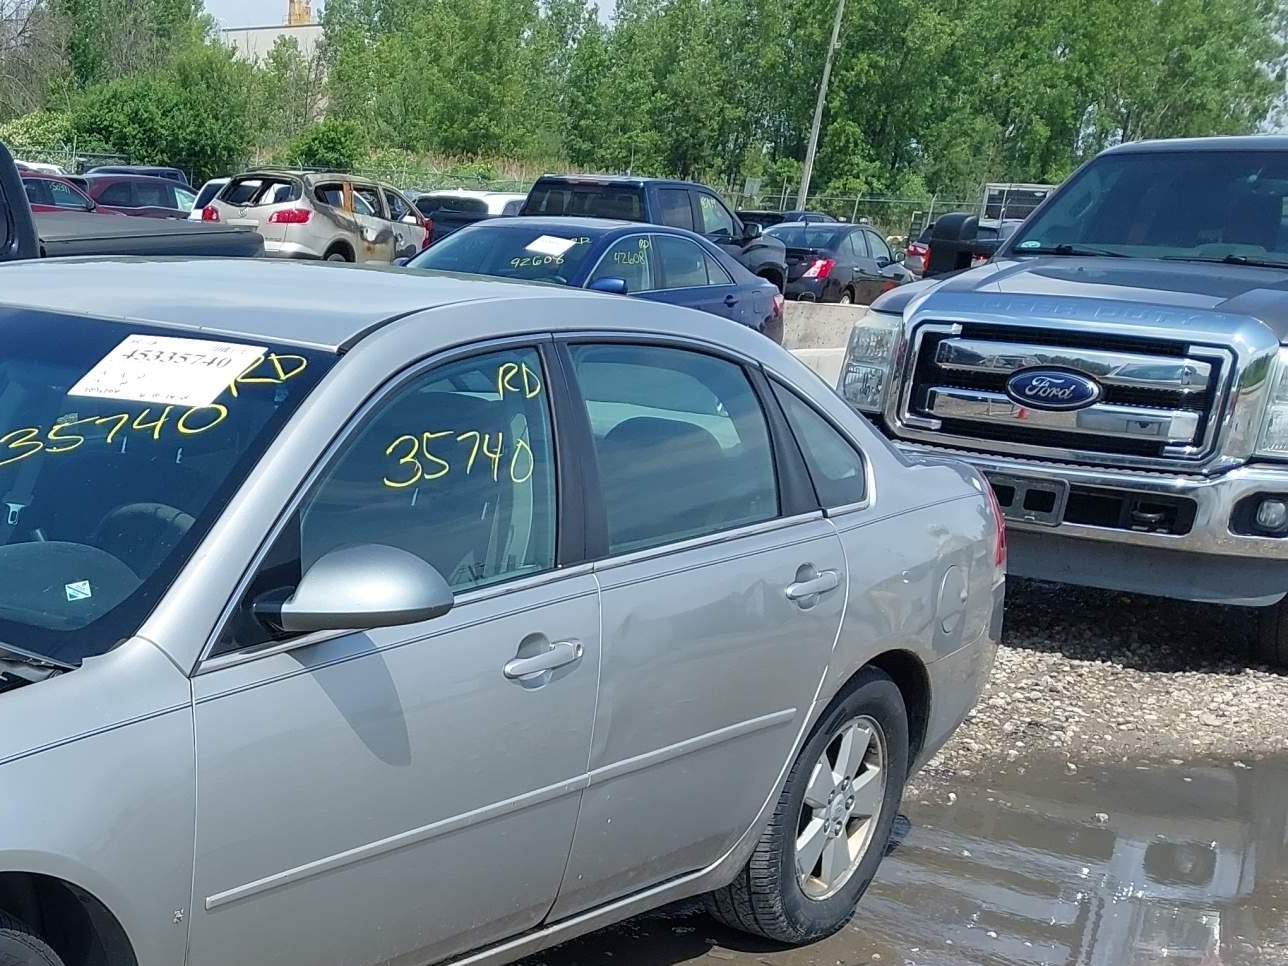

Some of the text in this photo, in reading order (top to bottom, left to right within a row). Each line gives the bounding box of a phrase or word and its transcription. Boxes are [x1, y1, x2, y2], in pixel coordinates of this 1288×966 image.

[614, 251, 646, 266] 92608
[121, 349, 233, 368] 45335740
[498, 362, 541, 401] RD
[1024, 376, 1074, 401] Ford
[383, 430, 534, 488] 35740
